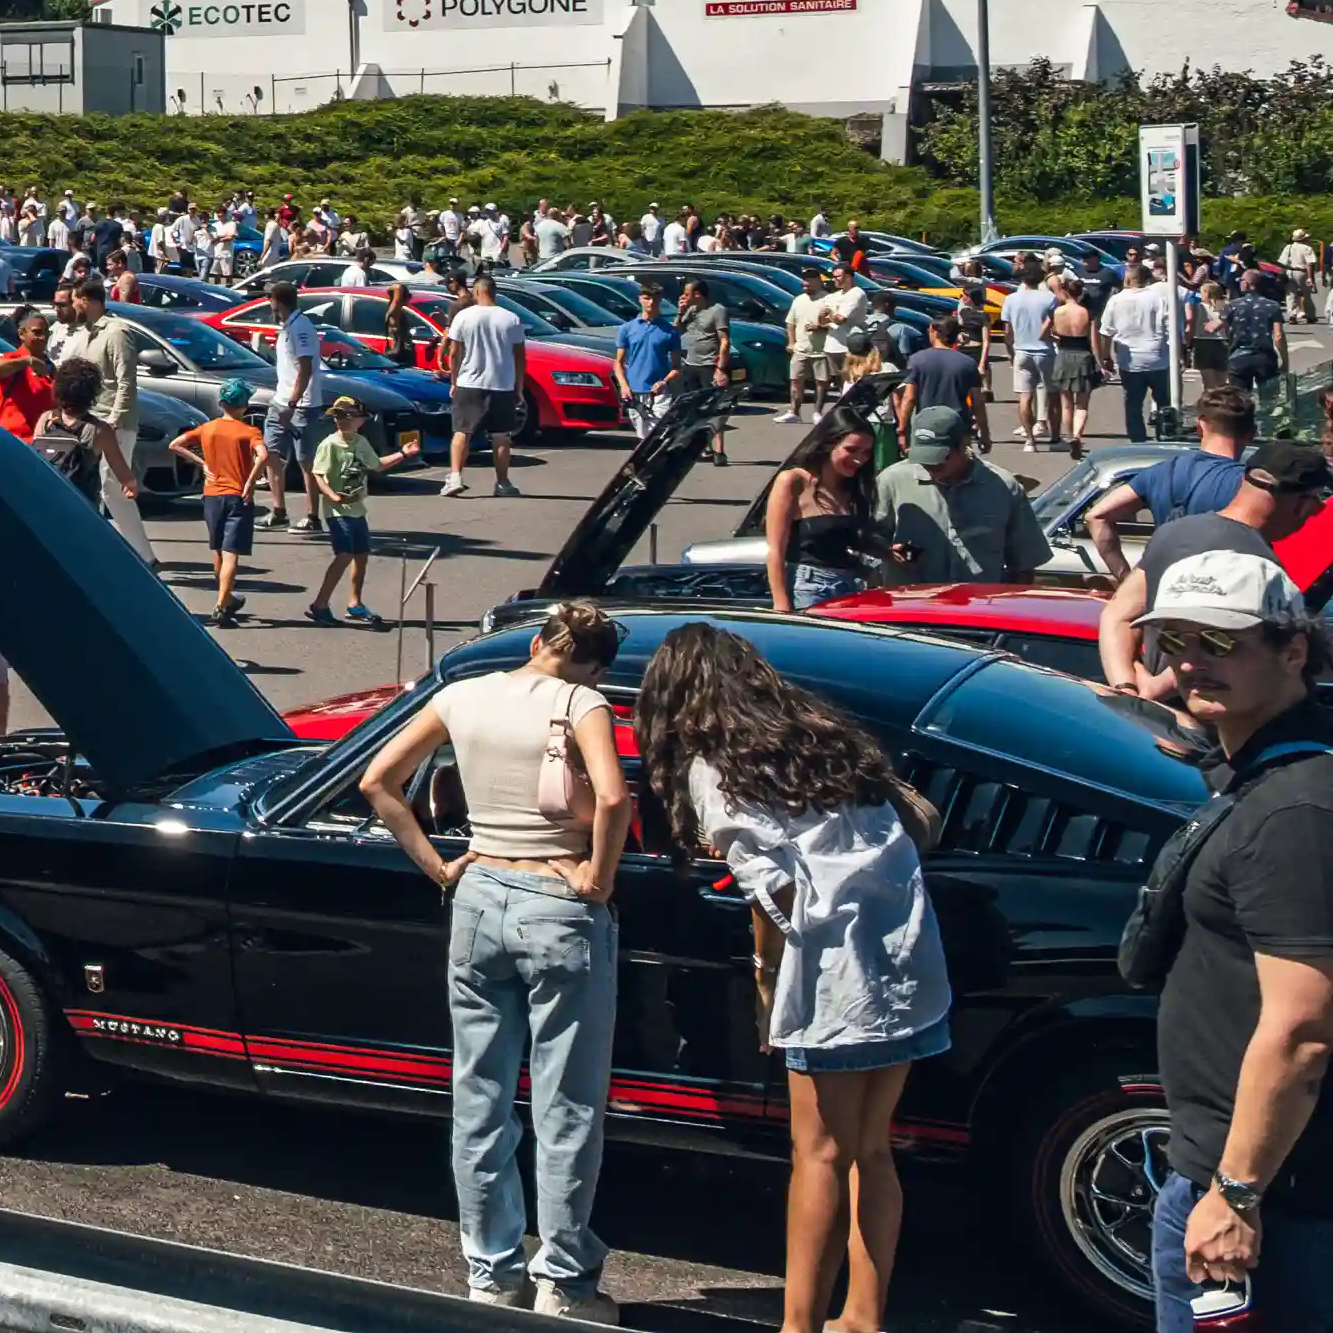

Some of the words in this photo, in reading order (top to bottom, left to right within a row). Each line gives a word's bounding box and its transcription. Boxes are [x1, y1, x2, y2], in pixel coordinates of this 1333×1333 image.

[188, 3, 291, 25] ECOTEC
[709, 5, 725, 15] LA
[728, 2, 786, 14] SOLUTION
[790, 0, 852, 11] SANITAIRE
[93, 1019, 180, 1041] MUSTANG
